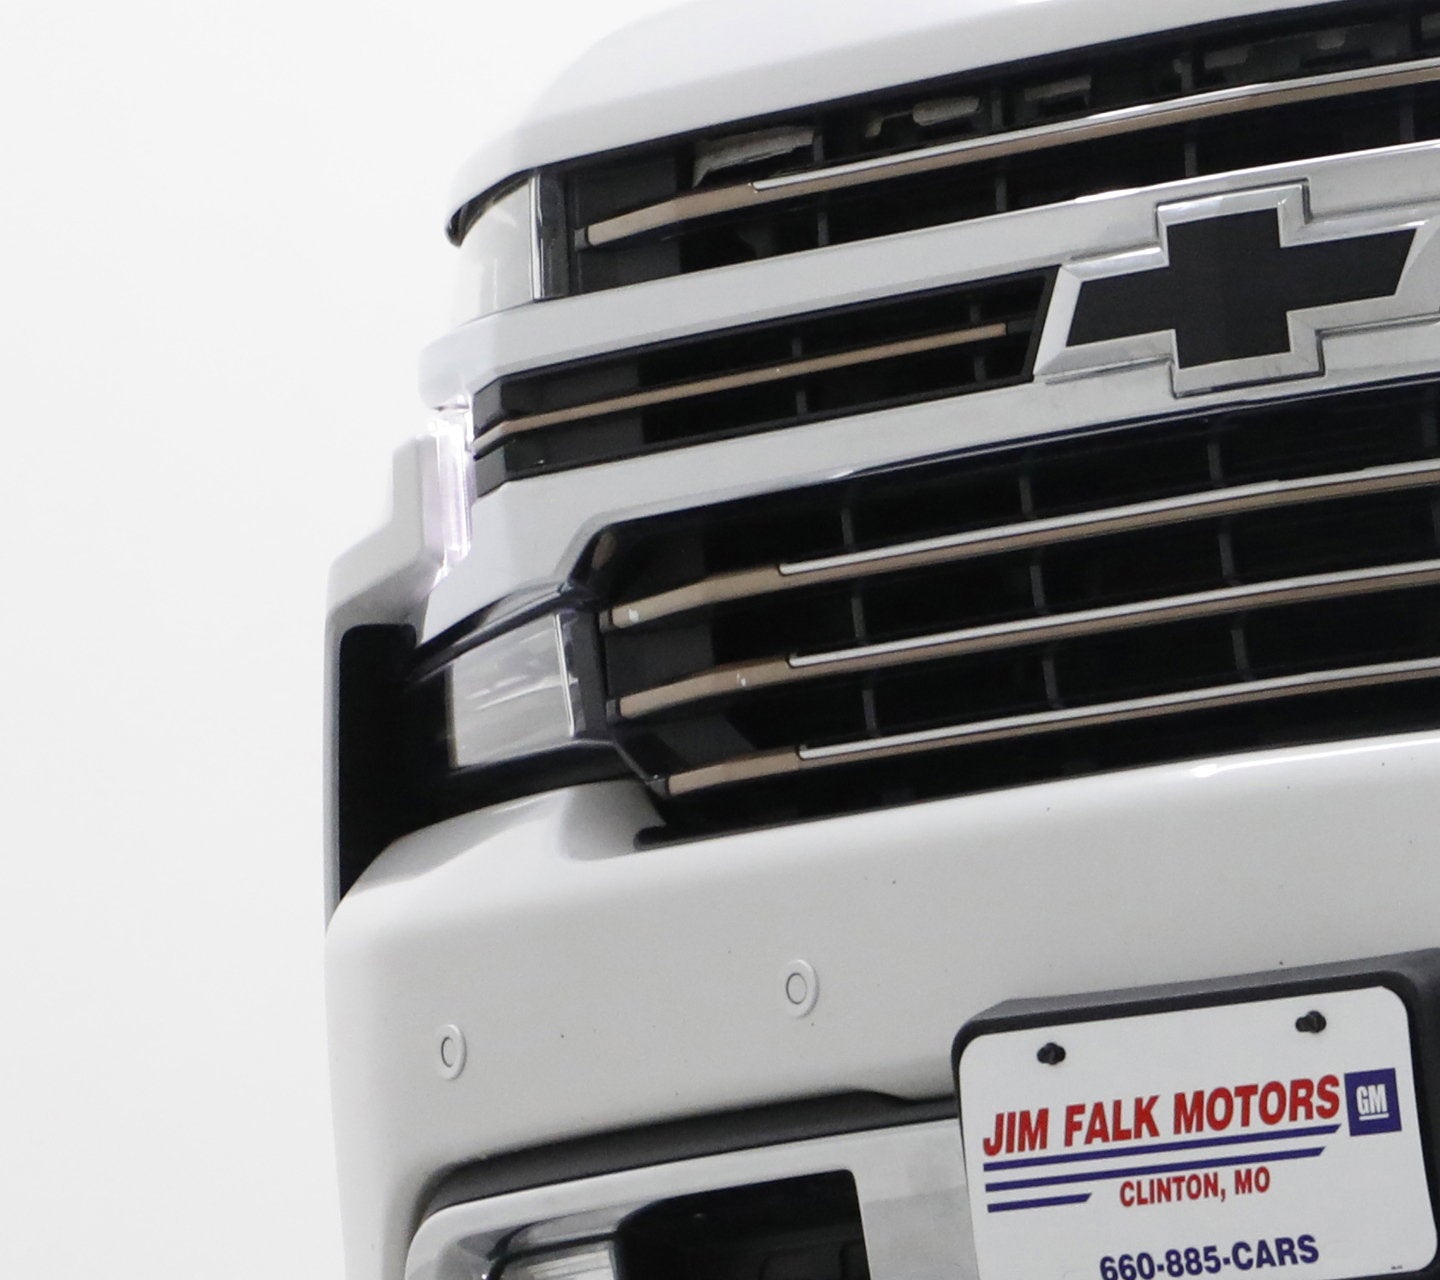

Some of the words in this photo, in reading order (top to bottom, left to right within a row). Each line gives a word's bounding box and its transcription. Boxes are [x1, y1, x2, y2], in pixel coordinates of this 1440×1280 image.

[982, 1108, 1049, 1157] JIM
[1064, 1096, 1160, 1147] FALK
[1174, 1075, 1341, 1134] MOTORS
[1356, 1085, 1389, 1118] GM
[1119, 1174, 1227, 1208] CLINTON,
[1235, 1167, 1271, 1194] MO
